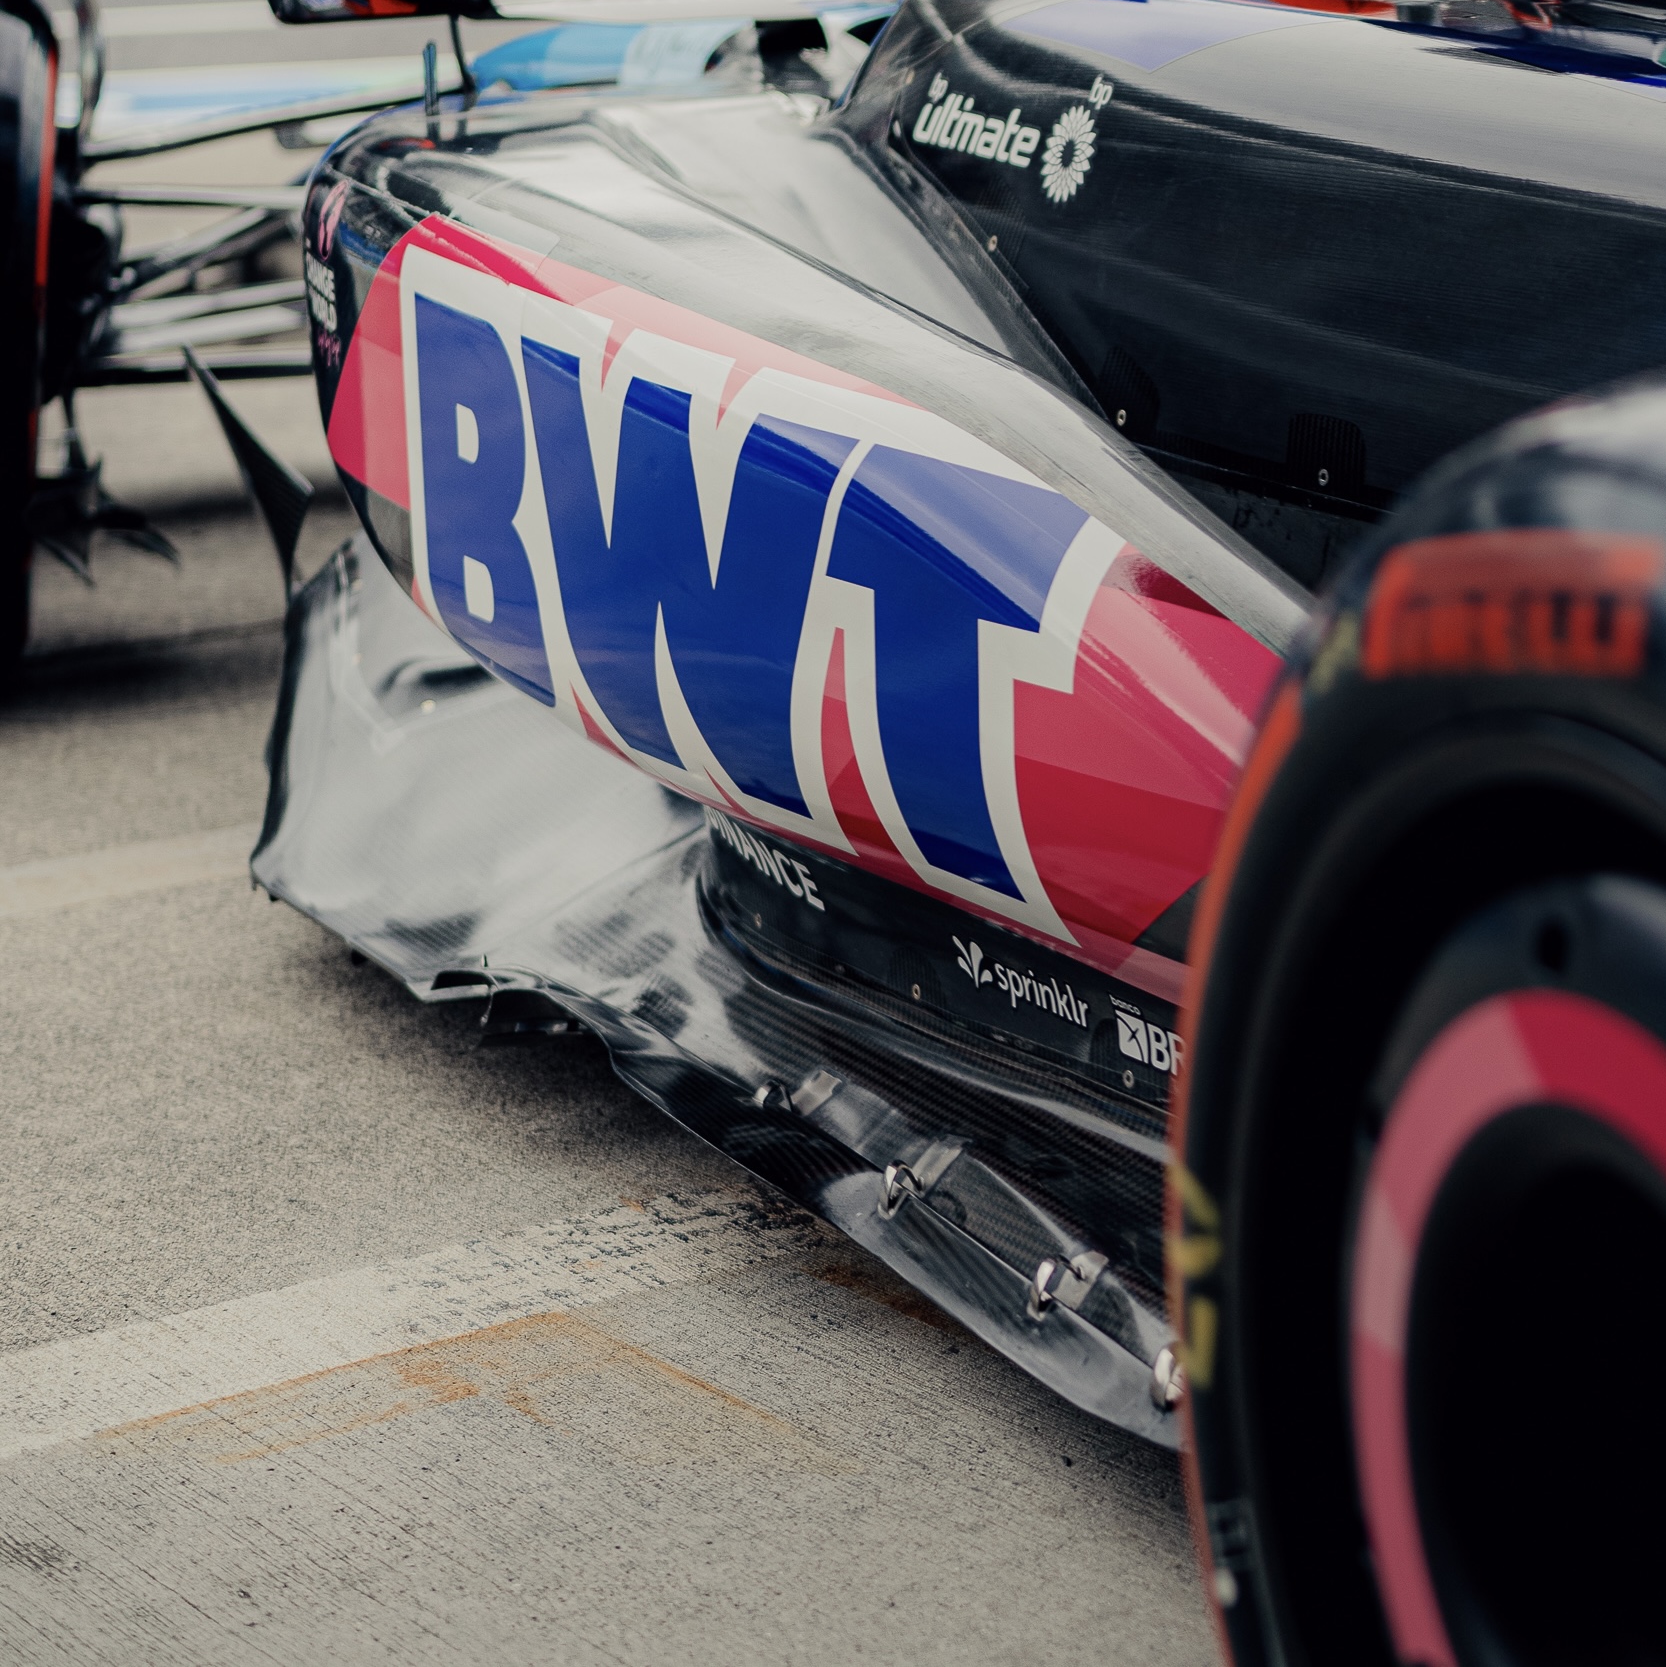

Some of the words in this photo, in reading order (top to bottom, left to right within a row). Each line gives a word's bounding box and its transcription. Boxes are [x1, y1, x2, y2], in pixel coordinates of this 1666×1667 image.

[928, 72, 948, 102] bp
[1088, 74, 1113, 110] bp
[912, 91, 1041, 169] ultimate
[412, 291, 1092, 904] BWT
[994, 962, 1089, 1028] sprinklr
[1109, 994, 1141, 1015] banco
